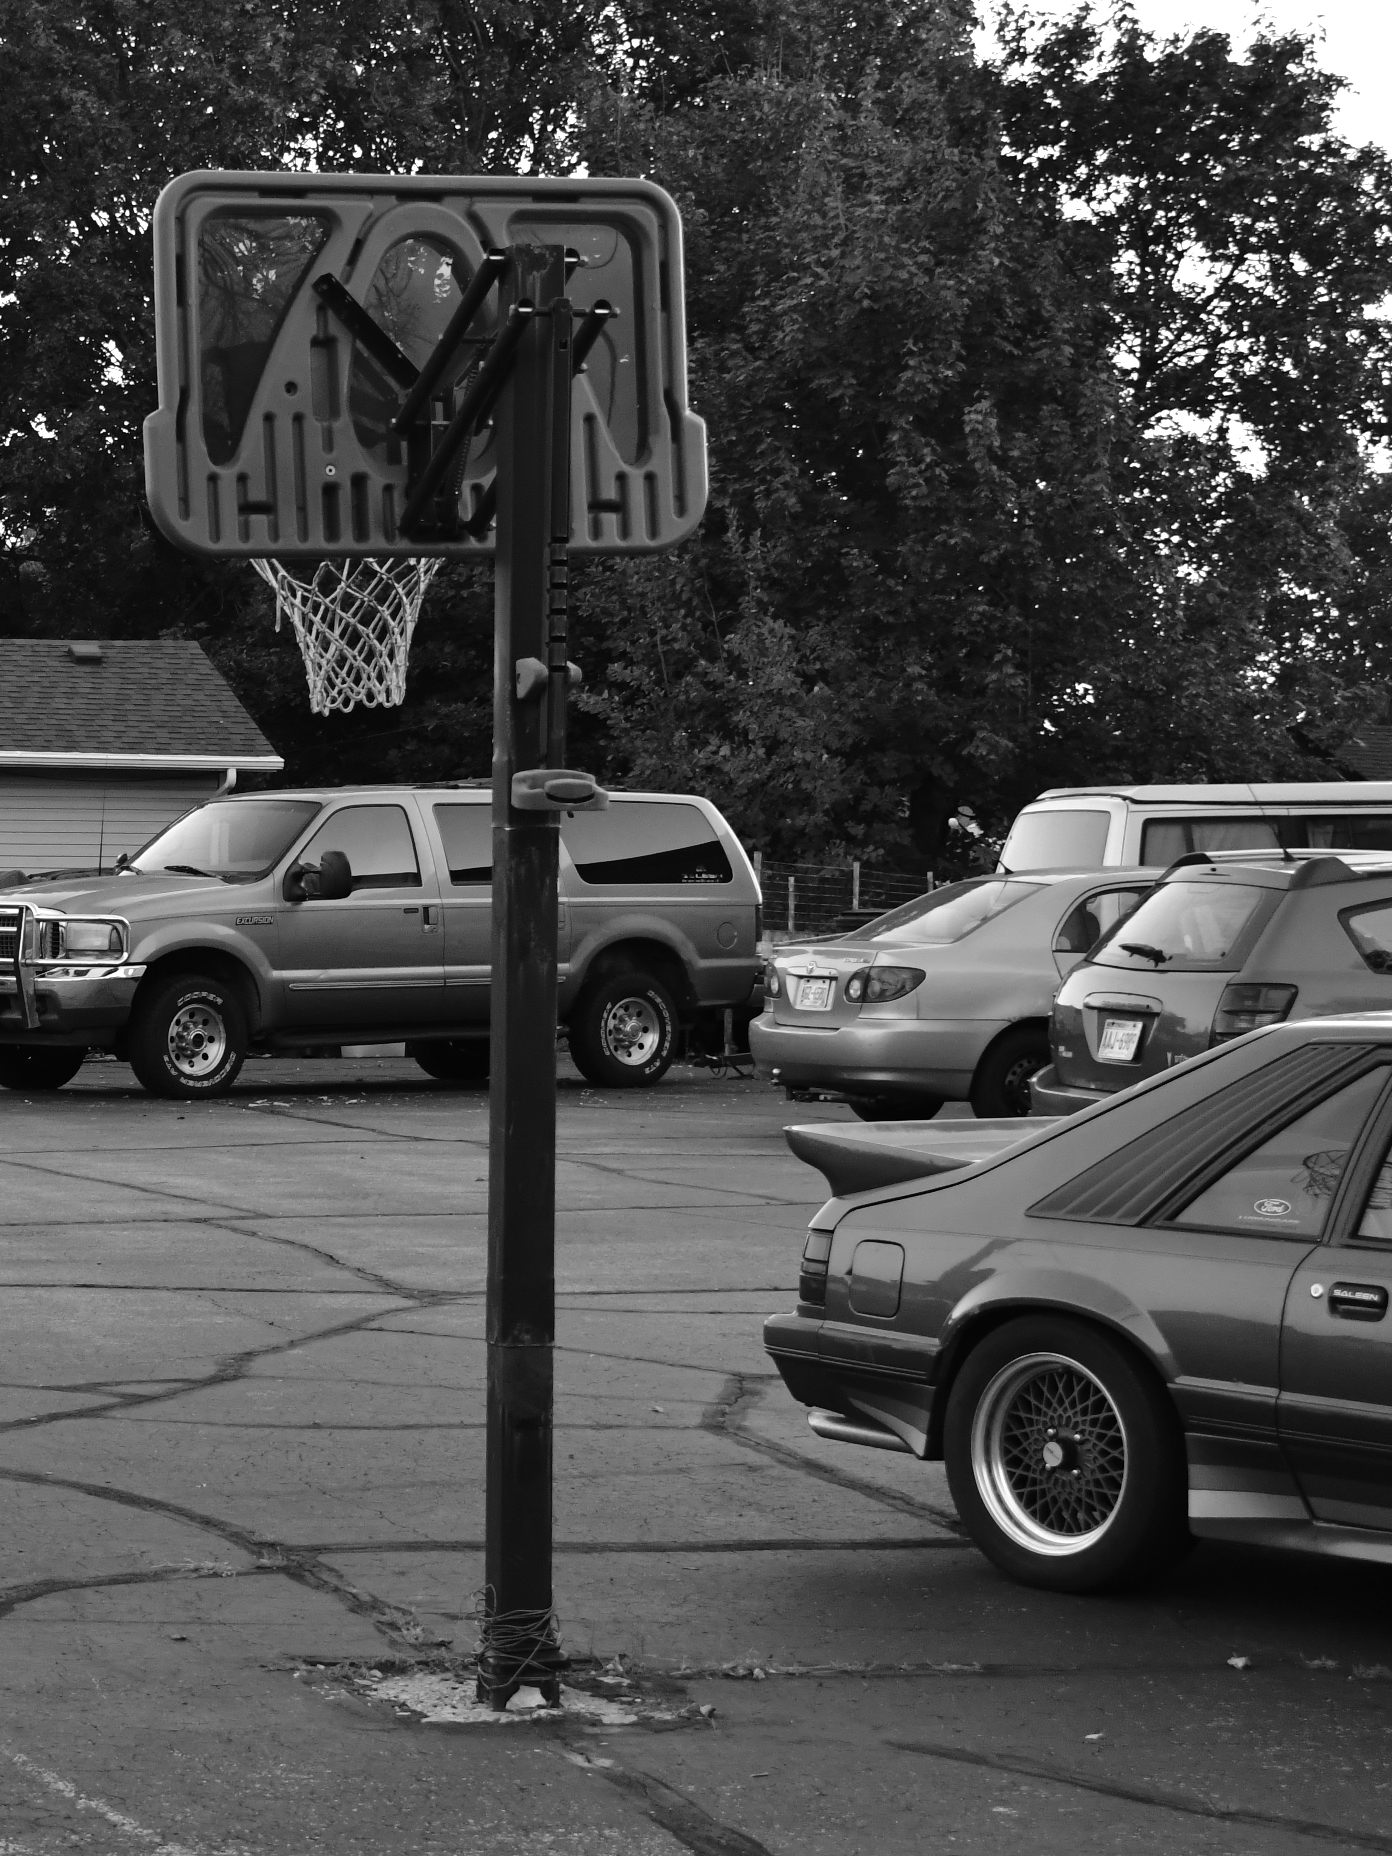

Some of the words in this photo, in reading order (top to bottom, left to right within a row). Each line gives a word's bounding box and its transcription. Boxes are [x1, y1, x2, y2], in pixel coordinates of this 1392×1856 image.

[236, 915, 274, 926] EXCURSION
[177, 991, 224, 1007] COOPER
[600, 1001, 612, 1056] COOPER
[179, 1051, 237, 1088] DISCOVERER
[1261, 1200, 1286, 1213] Ford
[1333, 1289, 1378, 1301] SALEEN
